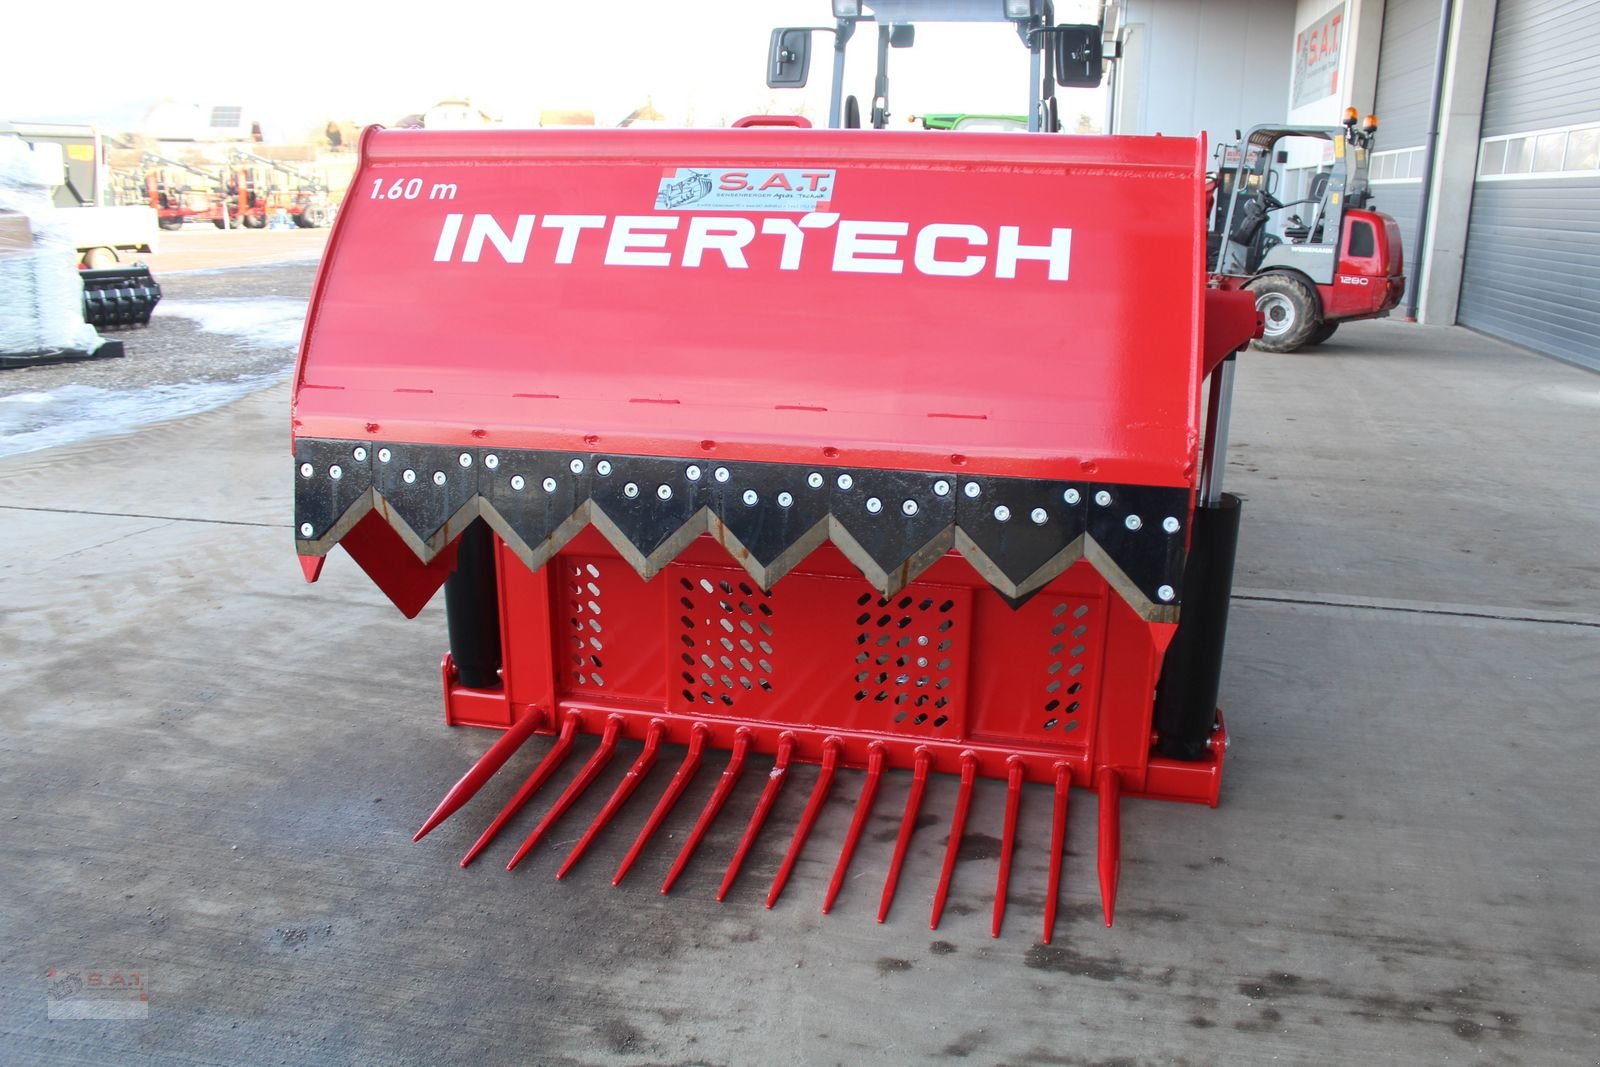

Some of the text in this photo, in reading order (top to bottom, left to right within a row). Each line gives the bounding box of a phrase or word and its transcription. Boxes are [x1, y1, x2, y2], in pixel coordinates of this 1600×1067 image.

[370, 178, 457, 200] 1.60 m
[719, 171, 830, 191] S.A.T.
[433, 212, 1072, 282] INTERTECH
[1340, 276, 1369, 286] 1280
